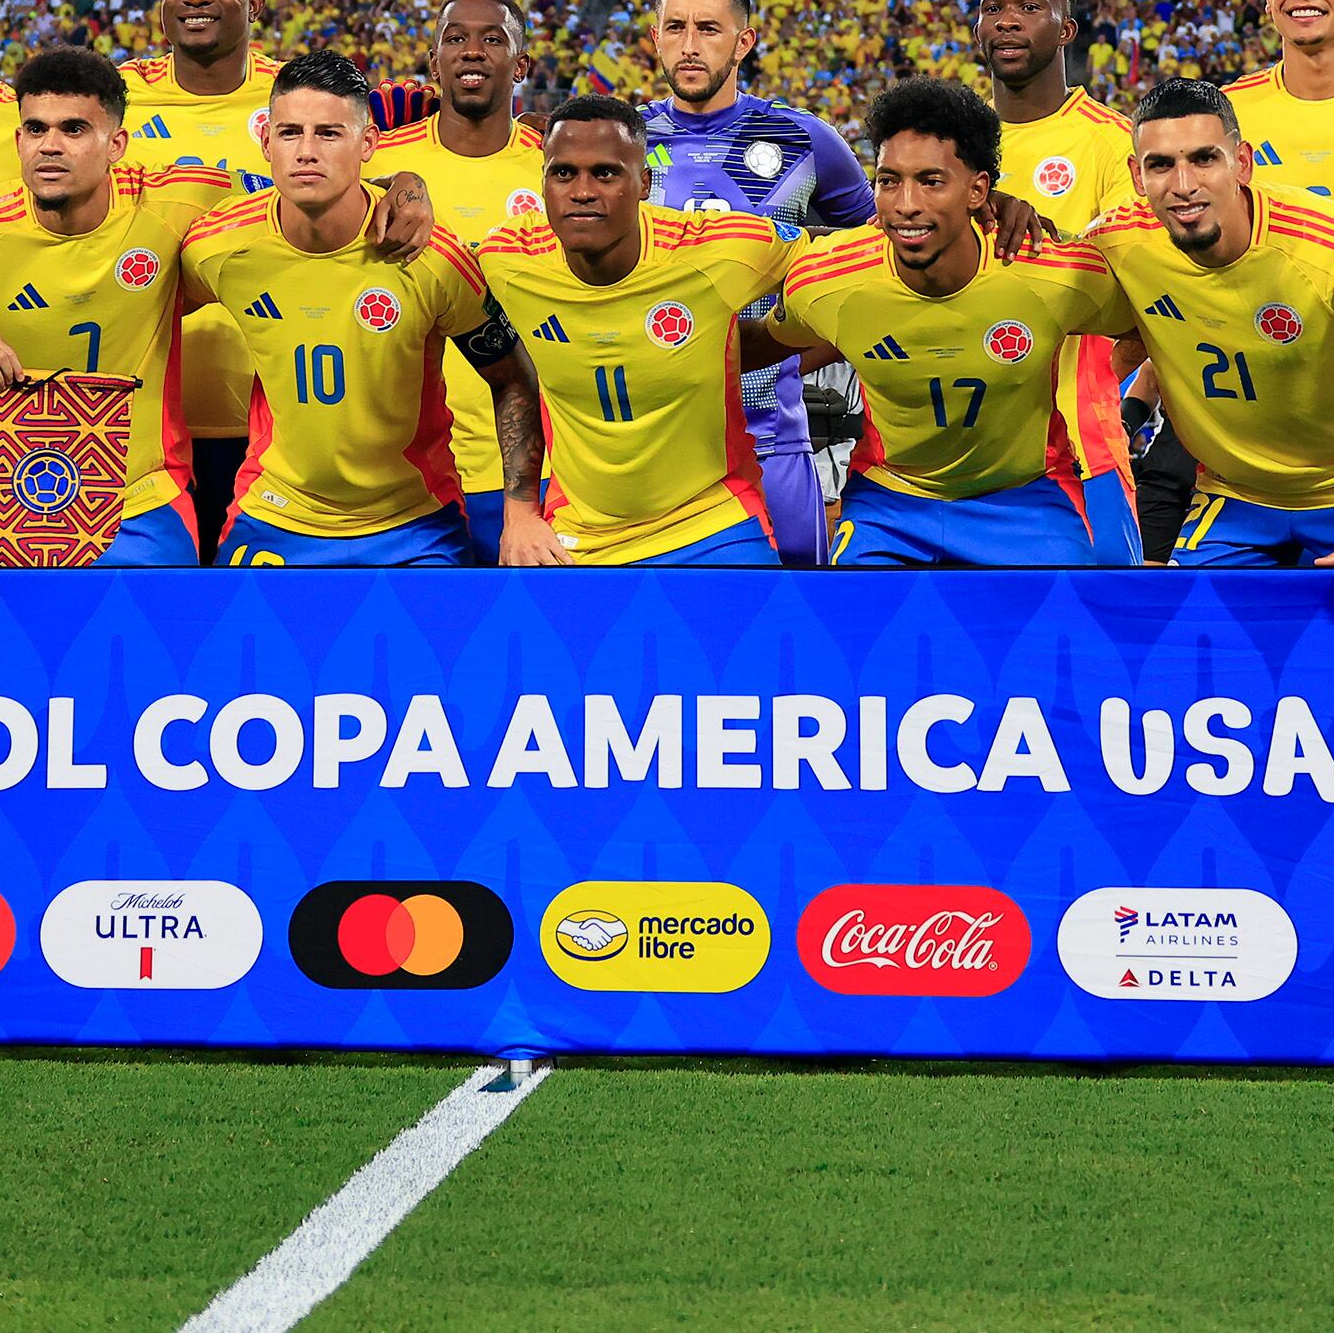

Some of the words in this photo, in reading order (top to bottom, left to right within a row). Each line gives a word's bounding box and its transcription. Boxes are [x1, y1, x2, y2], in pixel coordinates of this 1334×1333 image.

[69, 322, 101, 373] 7
[294, 343, 346, 405] 10
[1196, 342, 1257, 402] 21
[595, 365, 634, 423] 11
[931, 377, 988, 429] 17
[134, 694, 469, 790] COPA
[487, 695, 1070, 792] AMERICA
[110, 892, 184, 911] Michelob
[1146, 912, 1238, 928] LATAM
[95, 915, 204, 939] ULTRA
[639, 913, 755, 936] mercado
[821, 909, 1004, 970] Coca-Cola
[1146, 934, 1239, 946] AIRLINES
[639, 936, 695, 958] libre
[1148, 970, 1237, 987] DELTA
